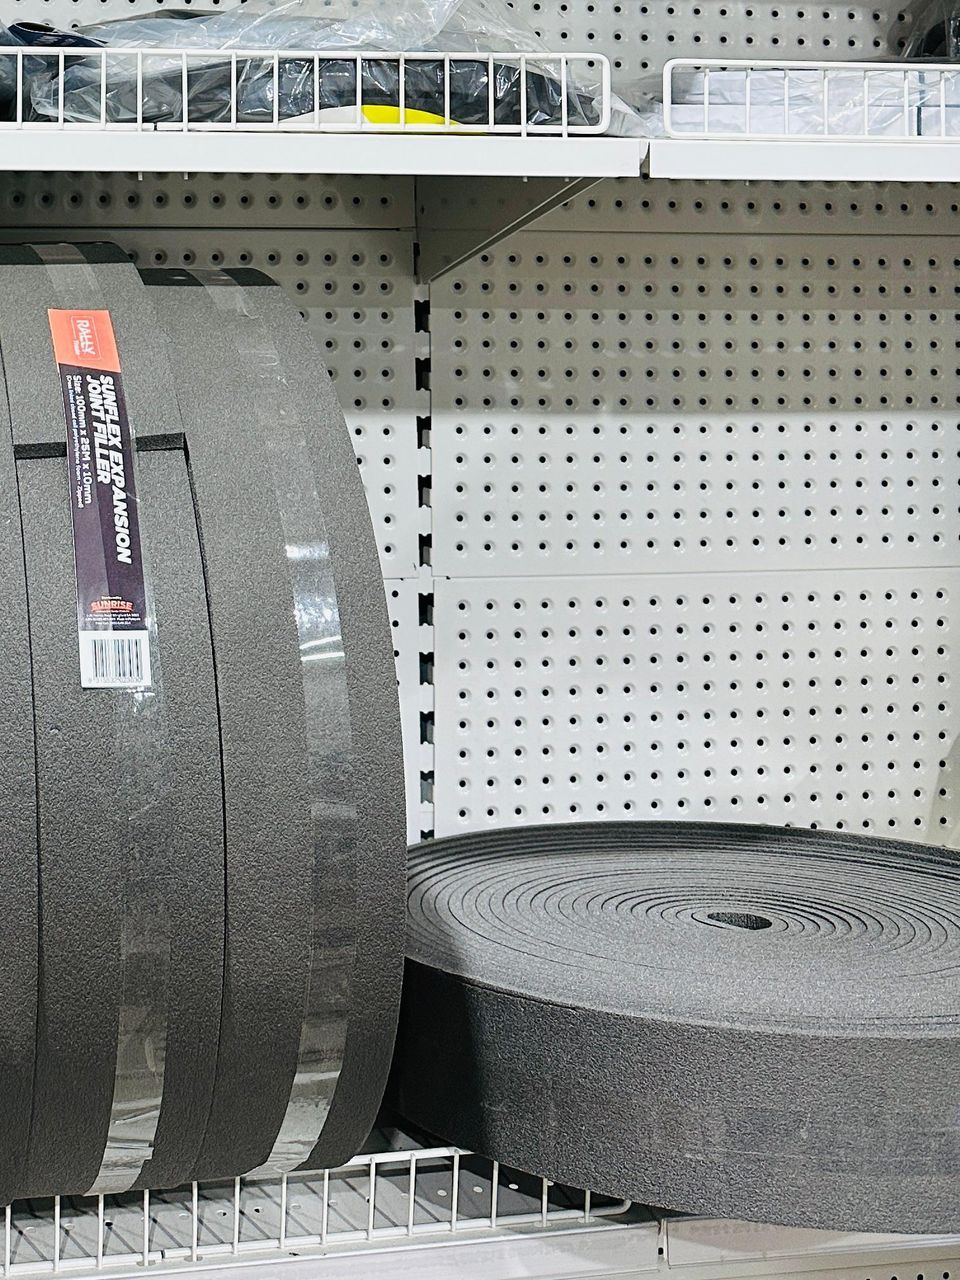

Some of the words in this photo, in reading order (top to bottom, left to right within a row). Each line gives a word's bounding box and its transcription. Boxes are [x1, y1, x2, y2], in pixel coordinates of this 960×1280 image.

[76, 320, 96, 355] RALLY
[73, 374, 82, 394] Size:
[86, 374, 106, 420] JOINT
[75, 395, 86, 428] 100mm
[100, 374, 122, 450] SUNFLEX
[80, 437, 91, 461] 25M
[93, 421, 111, 484] FILLER
[83, 471, 93, 504] 10mm
[110, 449, 132, 564] EXPANSION
[91, 600, 132, 610] SUNRISE
